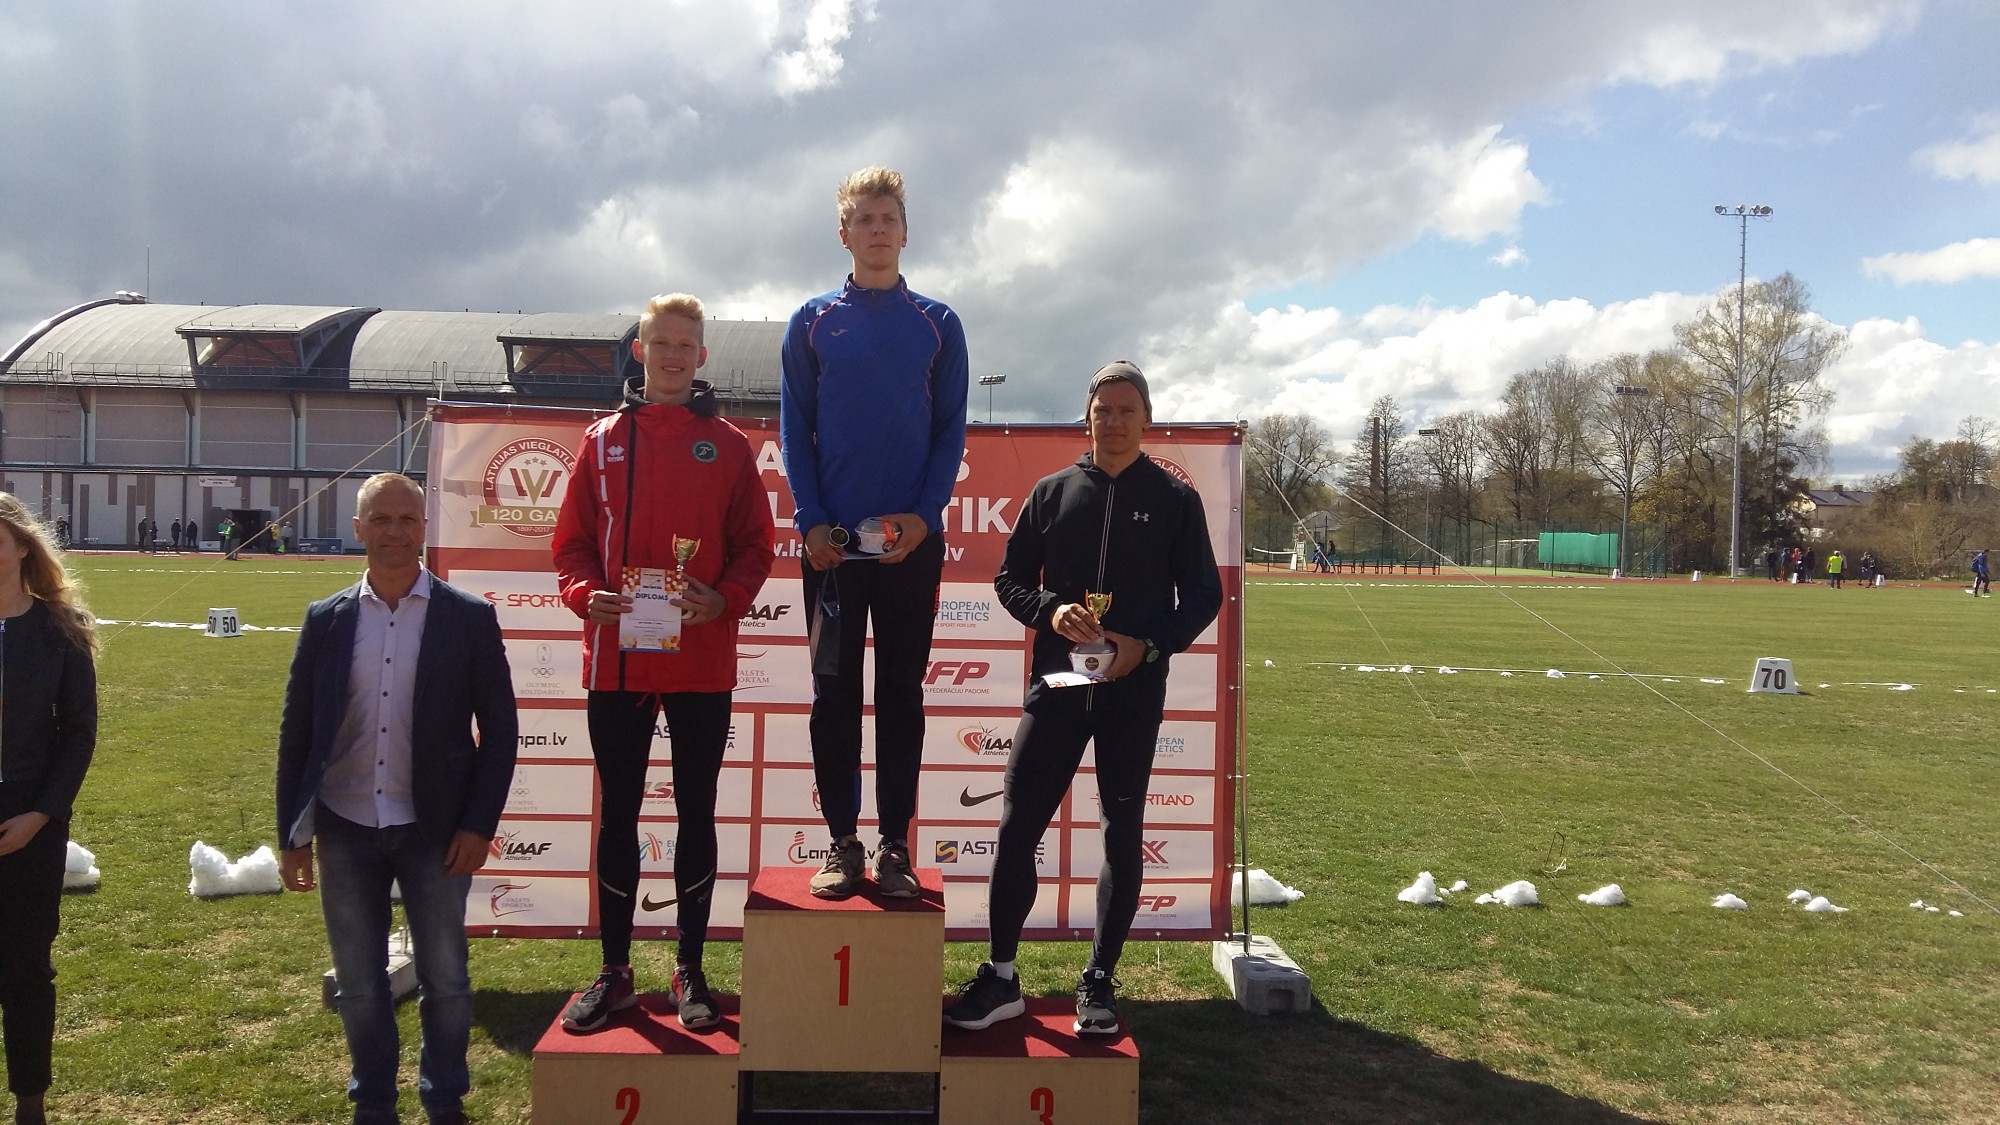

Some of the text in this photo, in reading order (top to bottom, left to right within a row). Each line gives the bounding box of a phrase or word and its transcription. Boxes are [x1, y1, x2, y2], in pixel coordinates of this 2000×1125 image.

[486, 446, 517, 490] LATVIJAS
[491, 508, 560, 522] 120 GA
[942, 497, 1024, 534] TIK
[507, 594, 567, 608] SPORT
[635, 593, 669, 601] DIPLOMS
[739, 604, 791, 620] AAF
[938, 601, 990, 611] ROPEAN
[222, 616, 237, 633] 50
[921, 661, 990, 685] FP
[1761, 668, 1786, 690] 70
[506, 843, 552, 855] IAAF
[834, 946, 850, 1006] 1
[615, 1087, 640, 1125] 2
